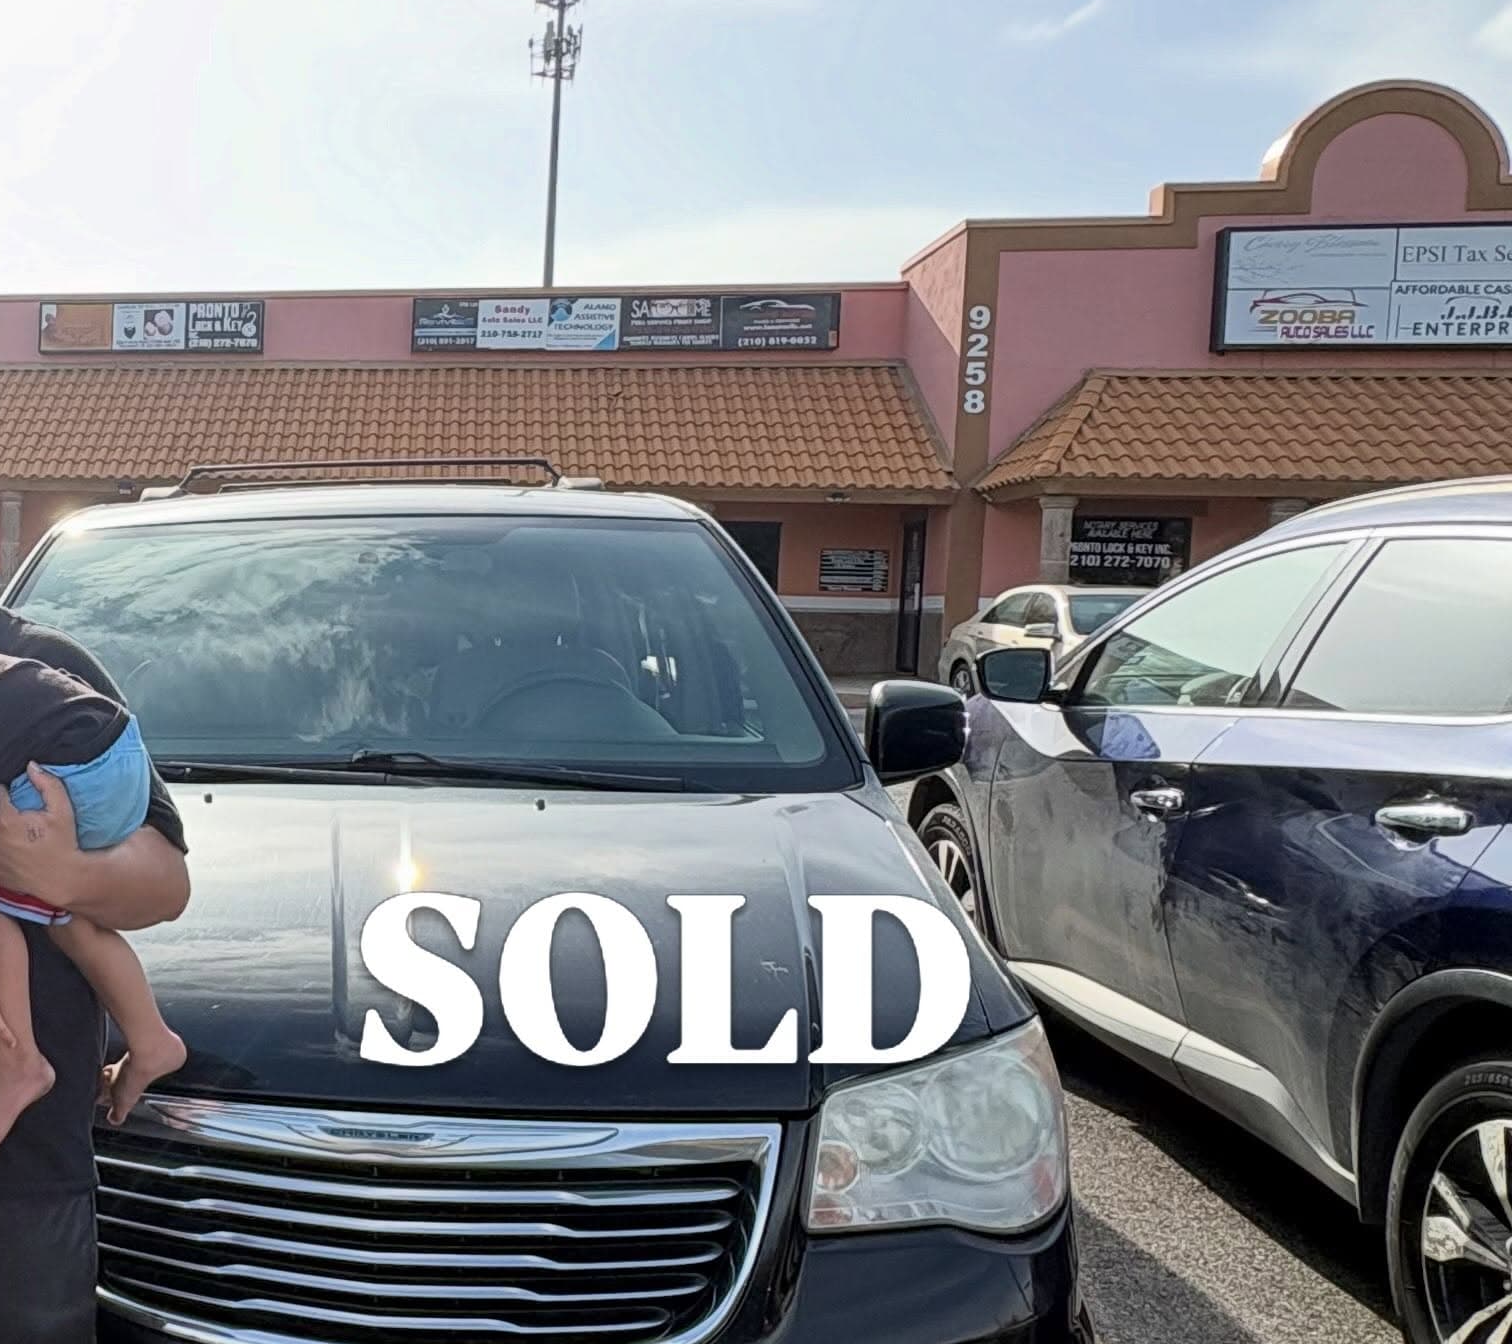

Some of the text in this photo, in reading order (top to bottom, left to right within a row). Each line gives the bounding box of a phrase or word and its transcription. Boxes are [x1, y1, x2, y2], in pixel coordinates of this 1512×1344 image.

[1402, 245, 1447, 263] EPSI
[1453, 245, 1488, 263] Tax
[1395, 284, 1481, 295] AFFORDABLE
[189, 303, 239, 318] PRONTO
[494, 304, 530, 315] Sandy
[584, 303, 617, 311] ALAMO
[1257, 309, 1355, 325] ZOOBA
[553, 323, 613, 331] TECHNOLOGY
[1279, 325, 1375, 339] AUTO SALES LLC
[963, 305, 991, 414] 9258
[1102, 542, 1126, 554] LOCK
[1135, 543, 1154, 555] KEY
[1103, 555, 1171, 568] 272-7070
